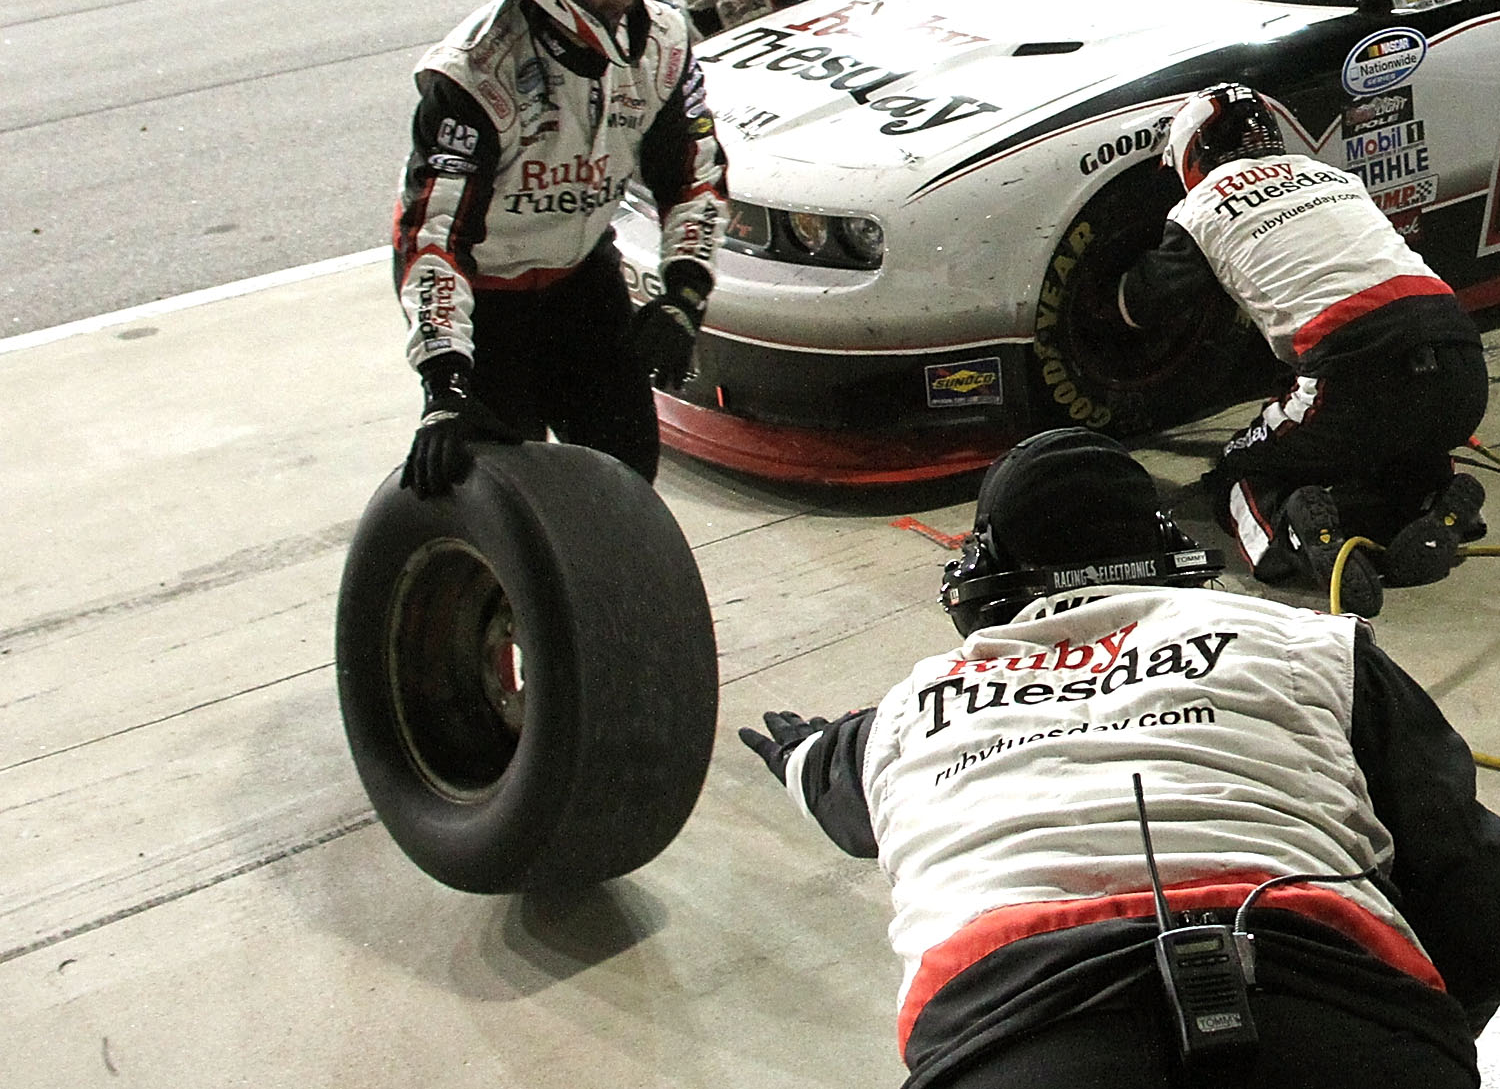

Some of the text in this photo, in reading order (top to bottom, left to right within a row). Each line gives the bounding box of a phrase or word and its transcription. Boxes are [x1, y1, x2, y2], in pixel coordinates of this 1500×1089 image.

[1380, 37, 1411, 55] NASCAR
[1360, 53, 1418, 77] Nationwide
[439, 121, 478, 153] PPG
[1354, 113, 1400, 132] POLE
[1346, 125, 1402, 162] Mobil
[519, 154, 610, 193] Ruby
[1211, 162, 1295, 201] Ruby
[1215, 170, 1349, 222] Tuesday
[934, 374, 994, 388] SUNOCO
[1053, 560, 1157, 589] RACING ELECTRONICS
[1175, 553, 1207, 564] TOMMY
[938, 622, 1138, 680] Ruby
[918, 632, 1238, 739] Tuesday
[935, 704, 1215, 787] rubytuesday.com
